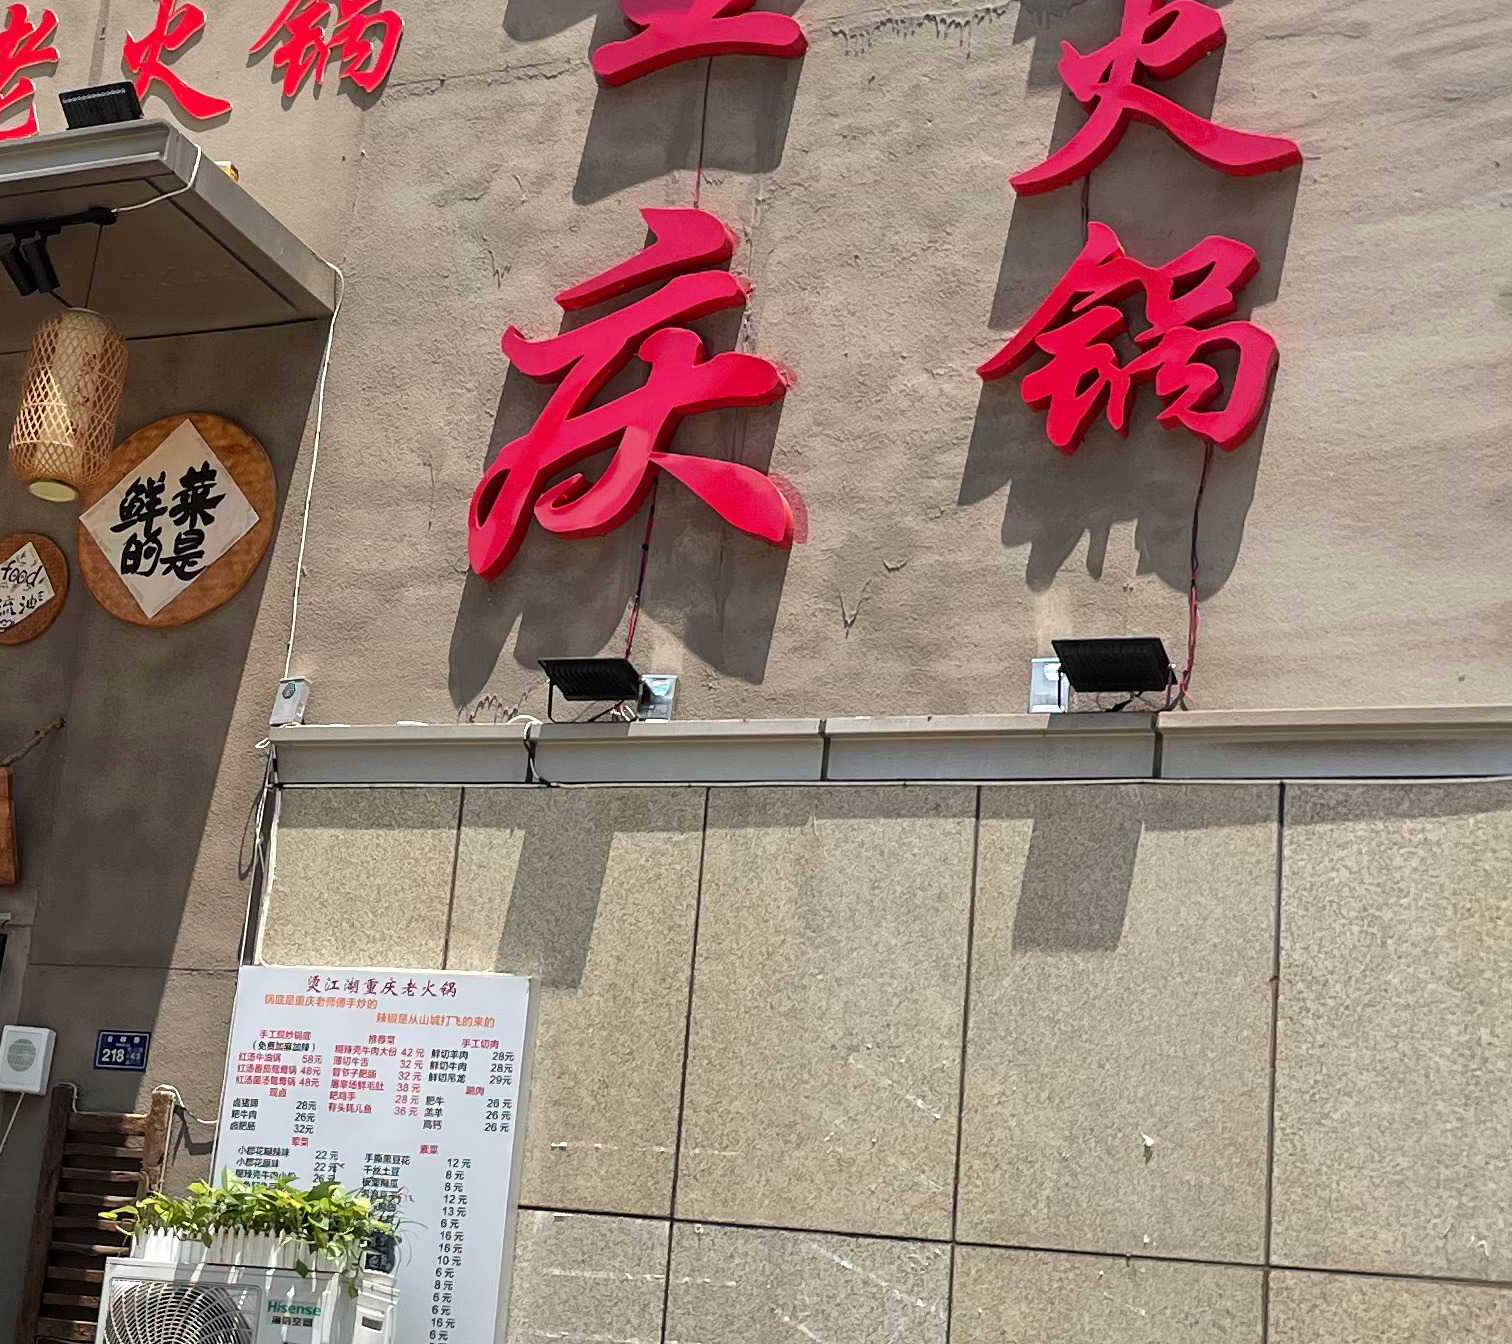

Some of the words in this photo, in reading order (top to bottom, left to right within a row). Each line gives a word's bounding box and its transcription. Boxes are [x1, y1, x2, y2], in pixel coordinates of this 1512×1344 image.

[1, 560, 43, 588] food
[306, 975, 457, 997] 烫江湖重庆老火锅
[265, 994, 377, 1009] 锅底是重庆老师傅手炒的
[376, 1013, 495, 1028] 辣椒是从山城打飞的来的
[101, 1048, 125, 1063] 218
[268, 1301, 321, 1317] Hisense
